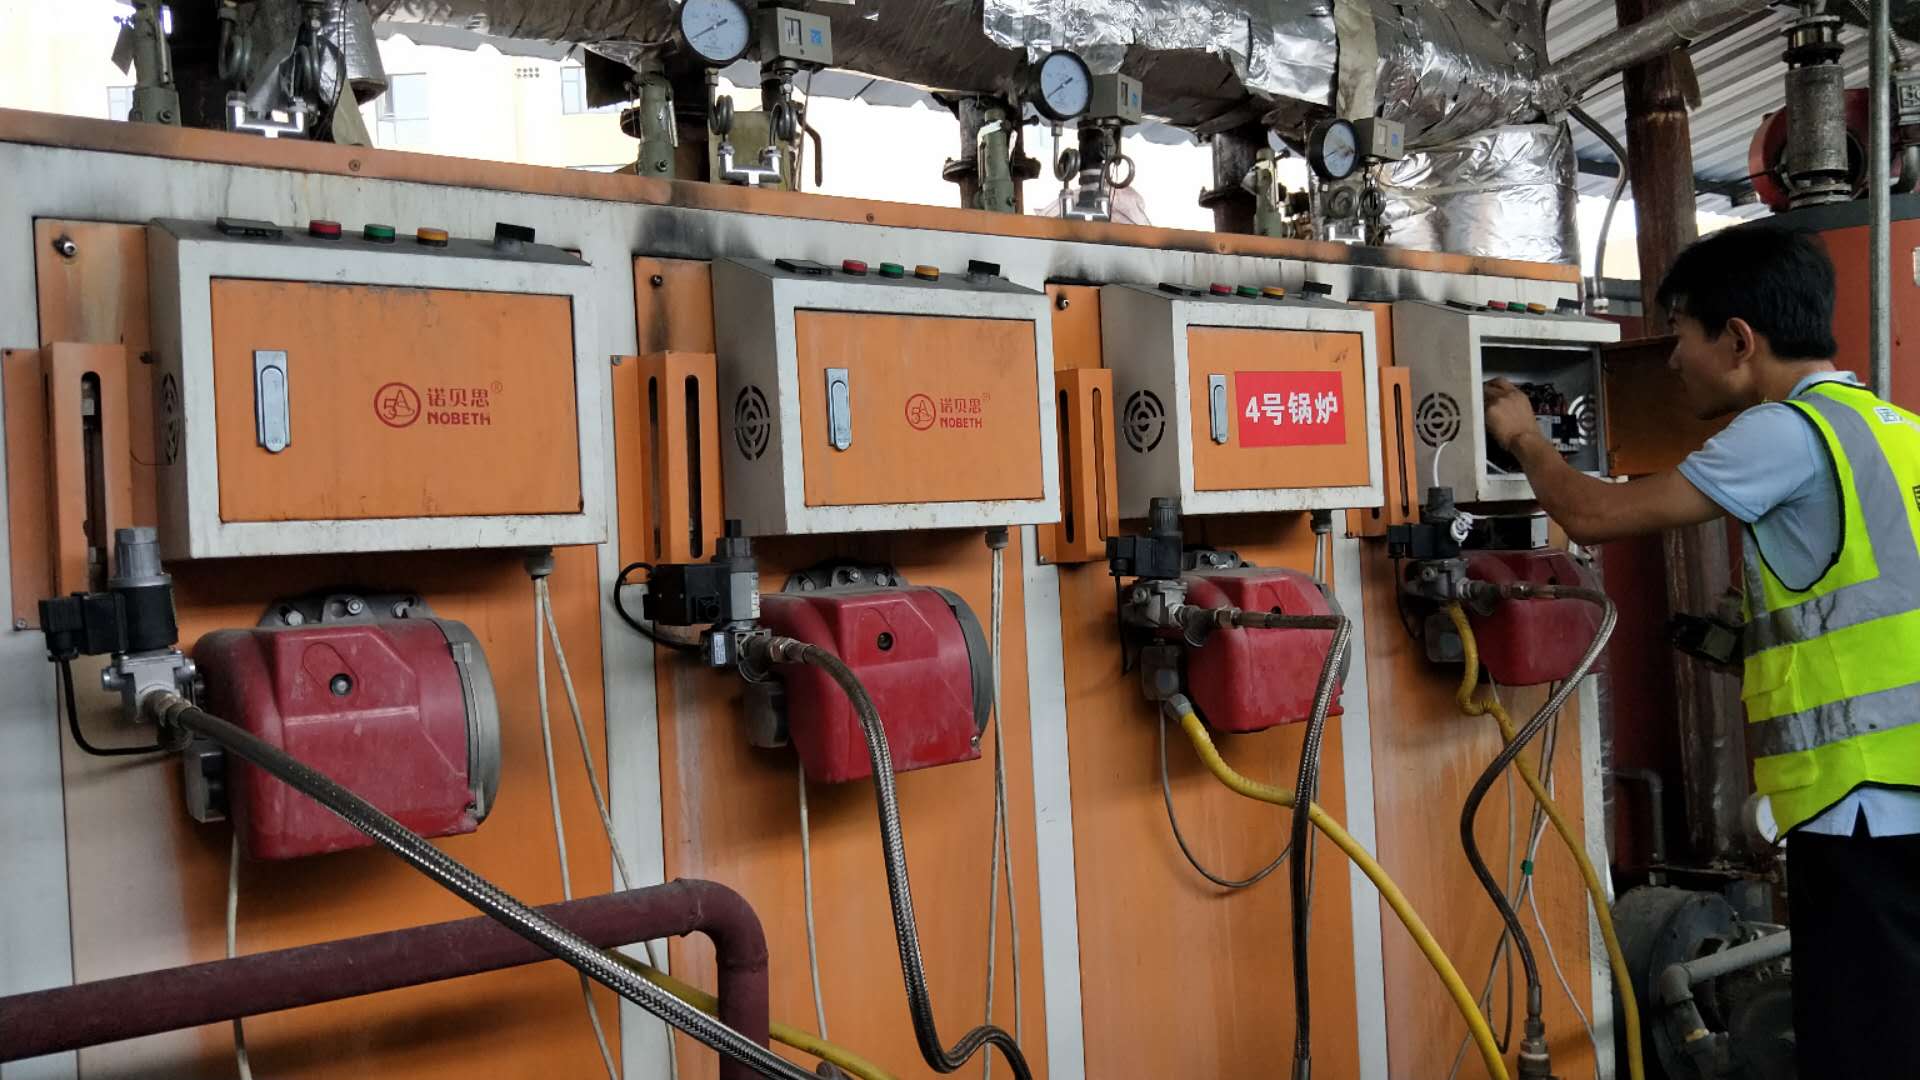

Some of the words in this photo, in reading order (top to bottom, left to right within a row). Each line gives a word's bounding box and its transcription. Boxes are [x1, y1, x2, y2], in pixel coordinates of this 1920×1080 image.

[1245, 391, 1338, 425] 4号锅炉
[427, 411, 491, 425] NOBETH
[940, 417, 983, 428] NOBETH
